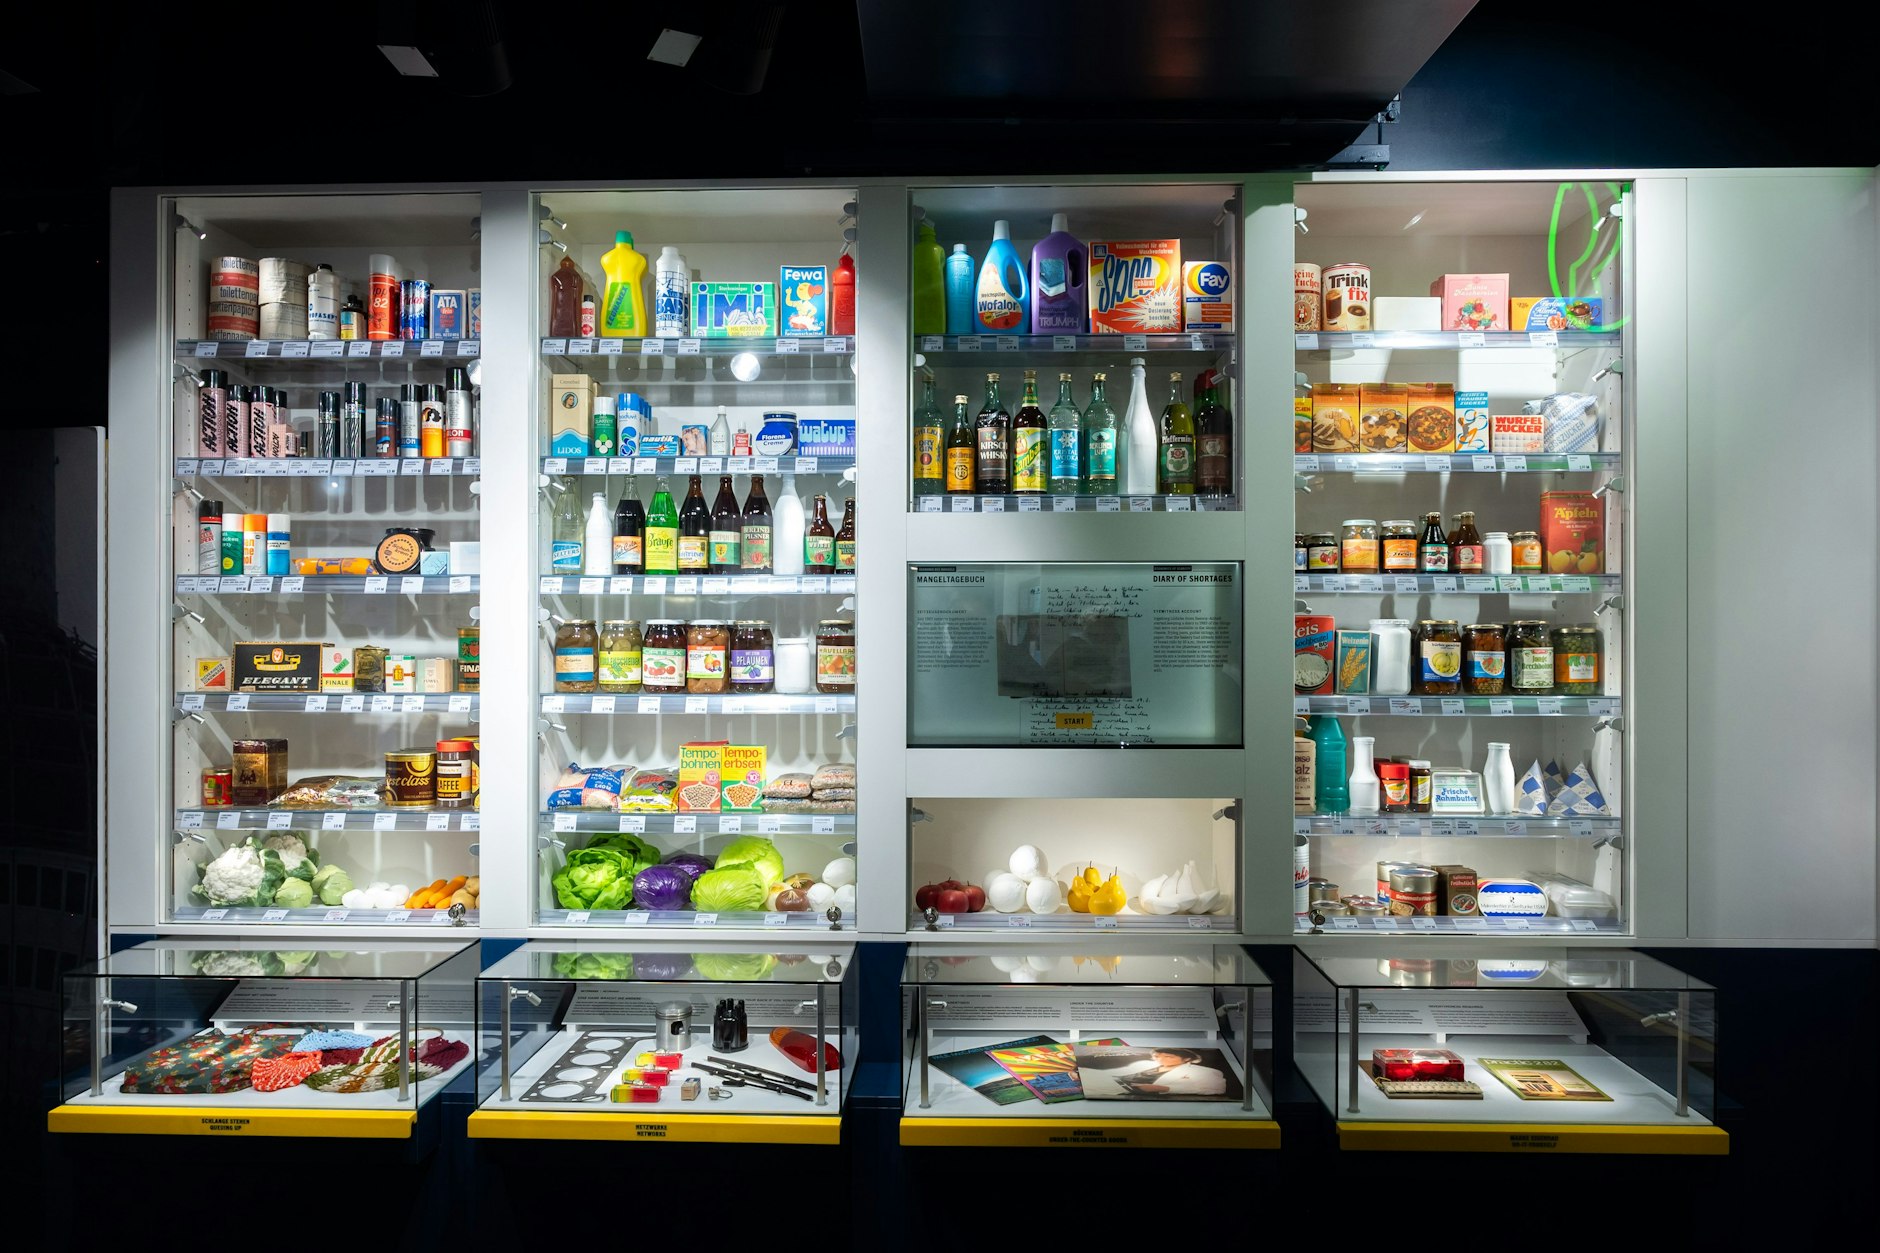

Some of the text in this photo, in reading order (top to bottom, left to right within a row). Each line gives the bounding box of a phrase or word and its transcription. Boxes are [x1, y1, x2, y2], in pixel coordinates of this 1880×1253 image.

[785, 269, 823, 281] Fewa
[1200, 272, 1228, 289] Fay
[1329, 273, 1368, 288] Trink
[1347, 287, 1368, 301] fix
[374, 298, 388, 308] 82
[437, 297, 458, 309] ATA
[656, 297, 683, 314] BAD
[978, 299, 1018, 312] Wofalor
[1039, 317, 1079, 327] TRIUMPH
[202, 392, 218, 453] ACTION
[227, 403, 238, 454] ACTION
[254, 407, 266, 458] ACTION
[1495, 425, 1542, 433] ZUCKER
[980, 451, 1008, 460] WHISKY
[1554, 507, 1598, 520] Äpfeln
[1153, 575, 1233, 583] DIARY OF SHORTAGES
[736, 656, 768, 665] PFLAUMEN
[681, 747, 719, 759] Tempo-
[723, 746, 762, 759] Tempo-
[681, 759, 721, 769] bohnen
[724, 759, 761, 769] erbsen
[401, 775, 430, 786] class
